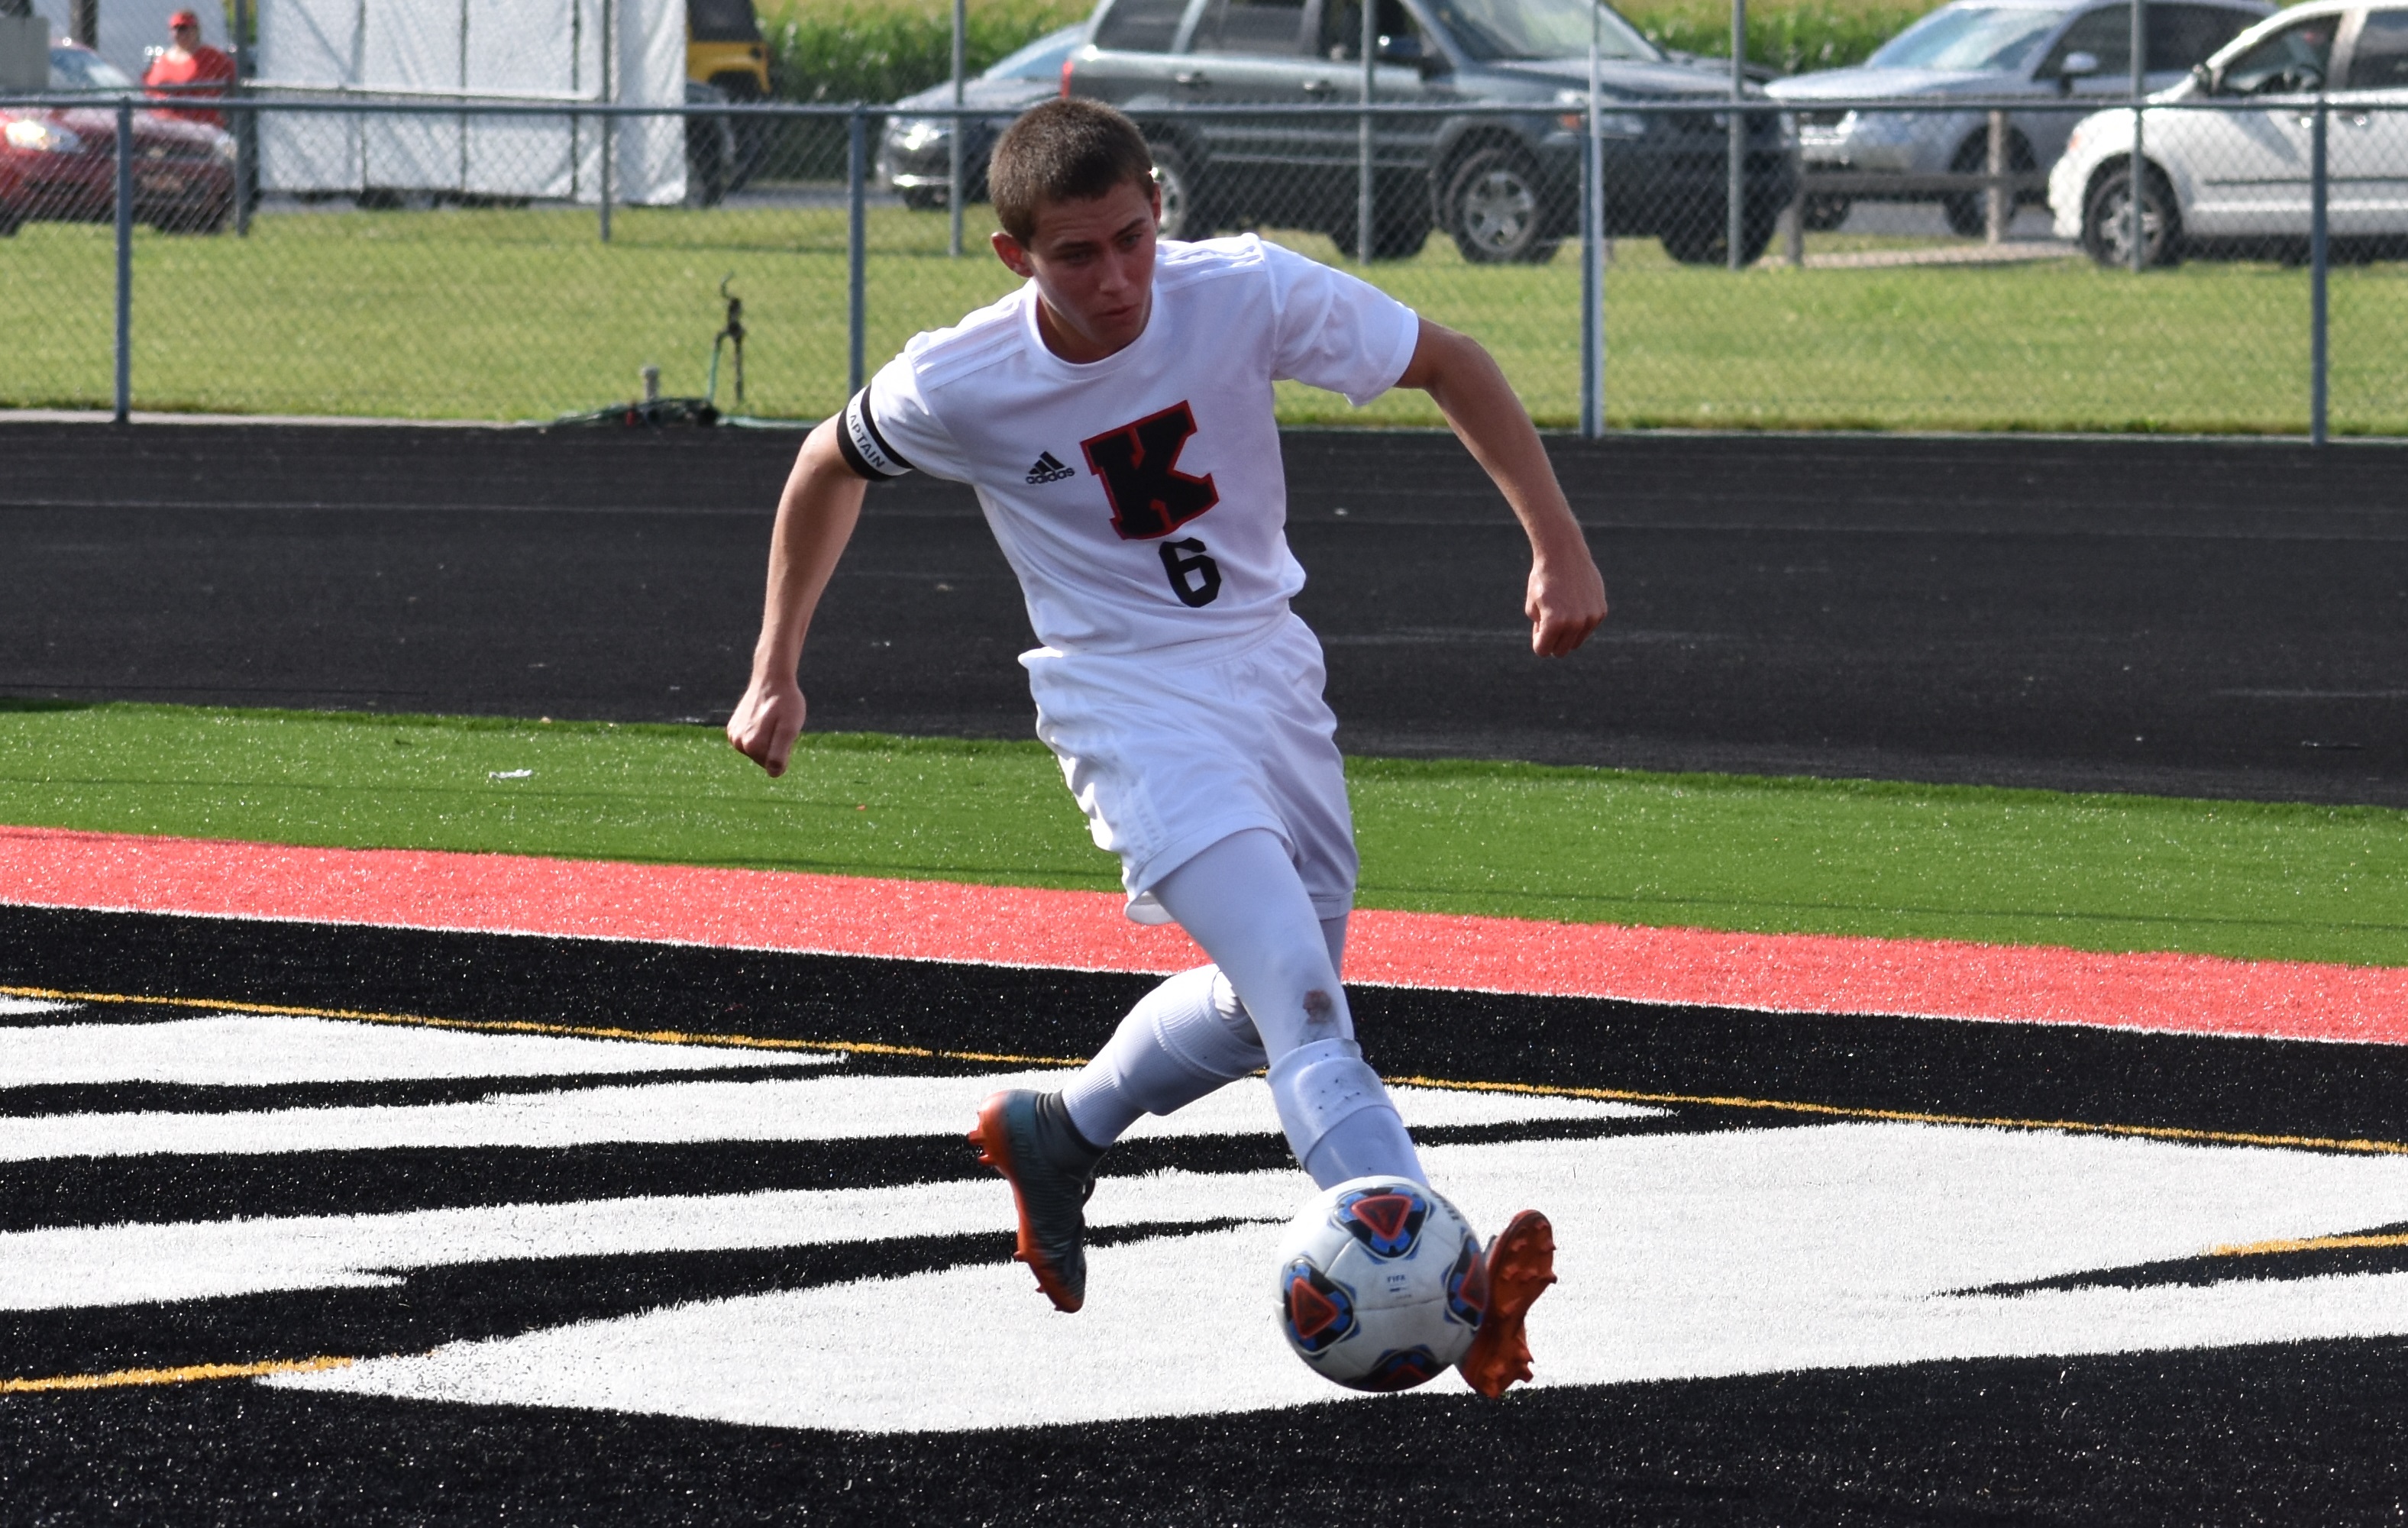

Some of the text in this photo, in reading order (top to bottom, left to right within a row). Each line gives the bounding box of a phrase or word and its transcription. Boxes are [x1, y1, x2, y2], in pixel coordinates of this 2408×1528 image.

[849, 404, 886, 468] APTAIN
[1026, 467, 1075, 484] adidas
[1080, 400, 1220, 541] K
[1159, 537, 1222, 608] 6
[1386, 1274, 1406, 1284] FIFA
